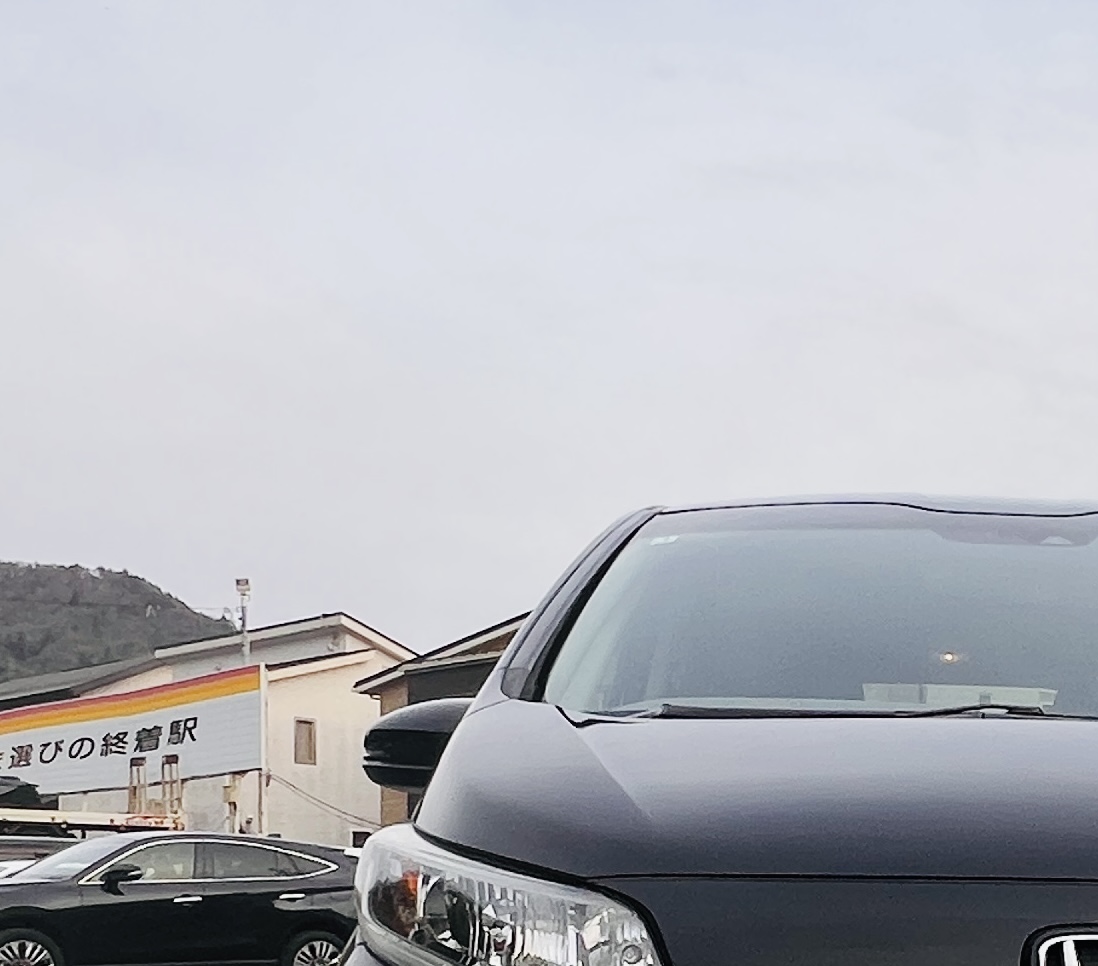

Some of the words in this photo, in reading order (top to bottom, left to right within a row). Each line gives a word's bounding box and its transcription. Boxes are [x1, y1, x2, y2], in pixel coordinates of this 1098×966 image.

[0, 716, 198, 770] 選びの終着駅
